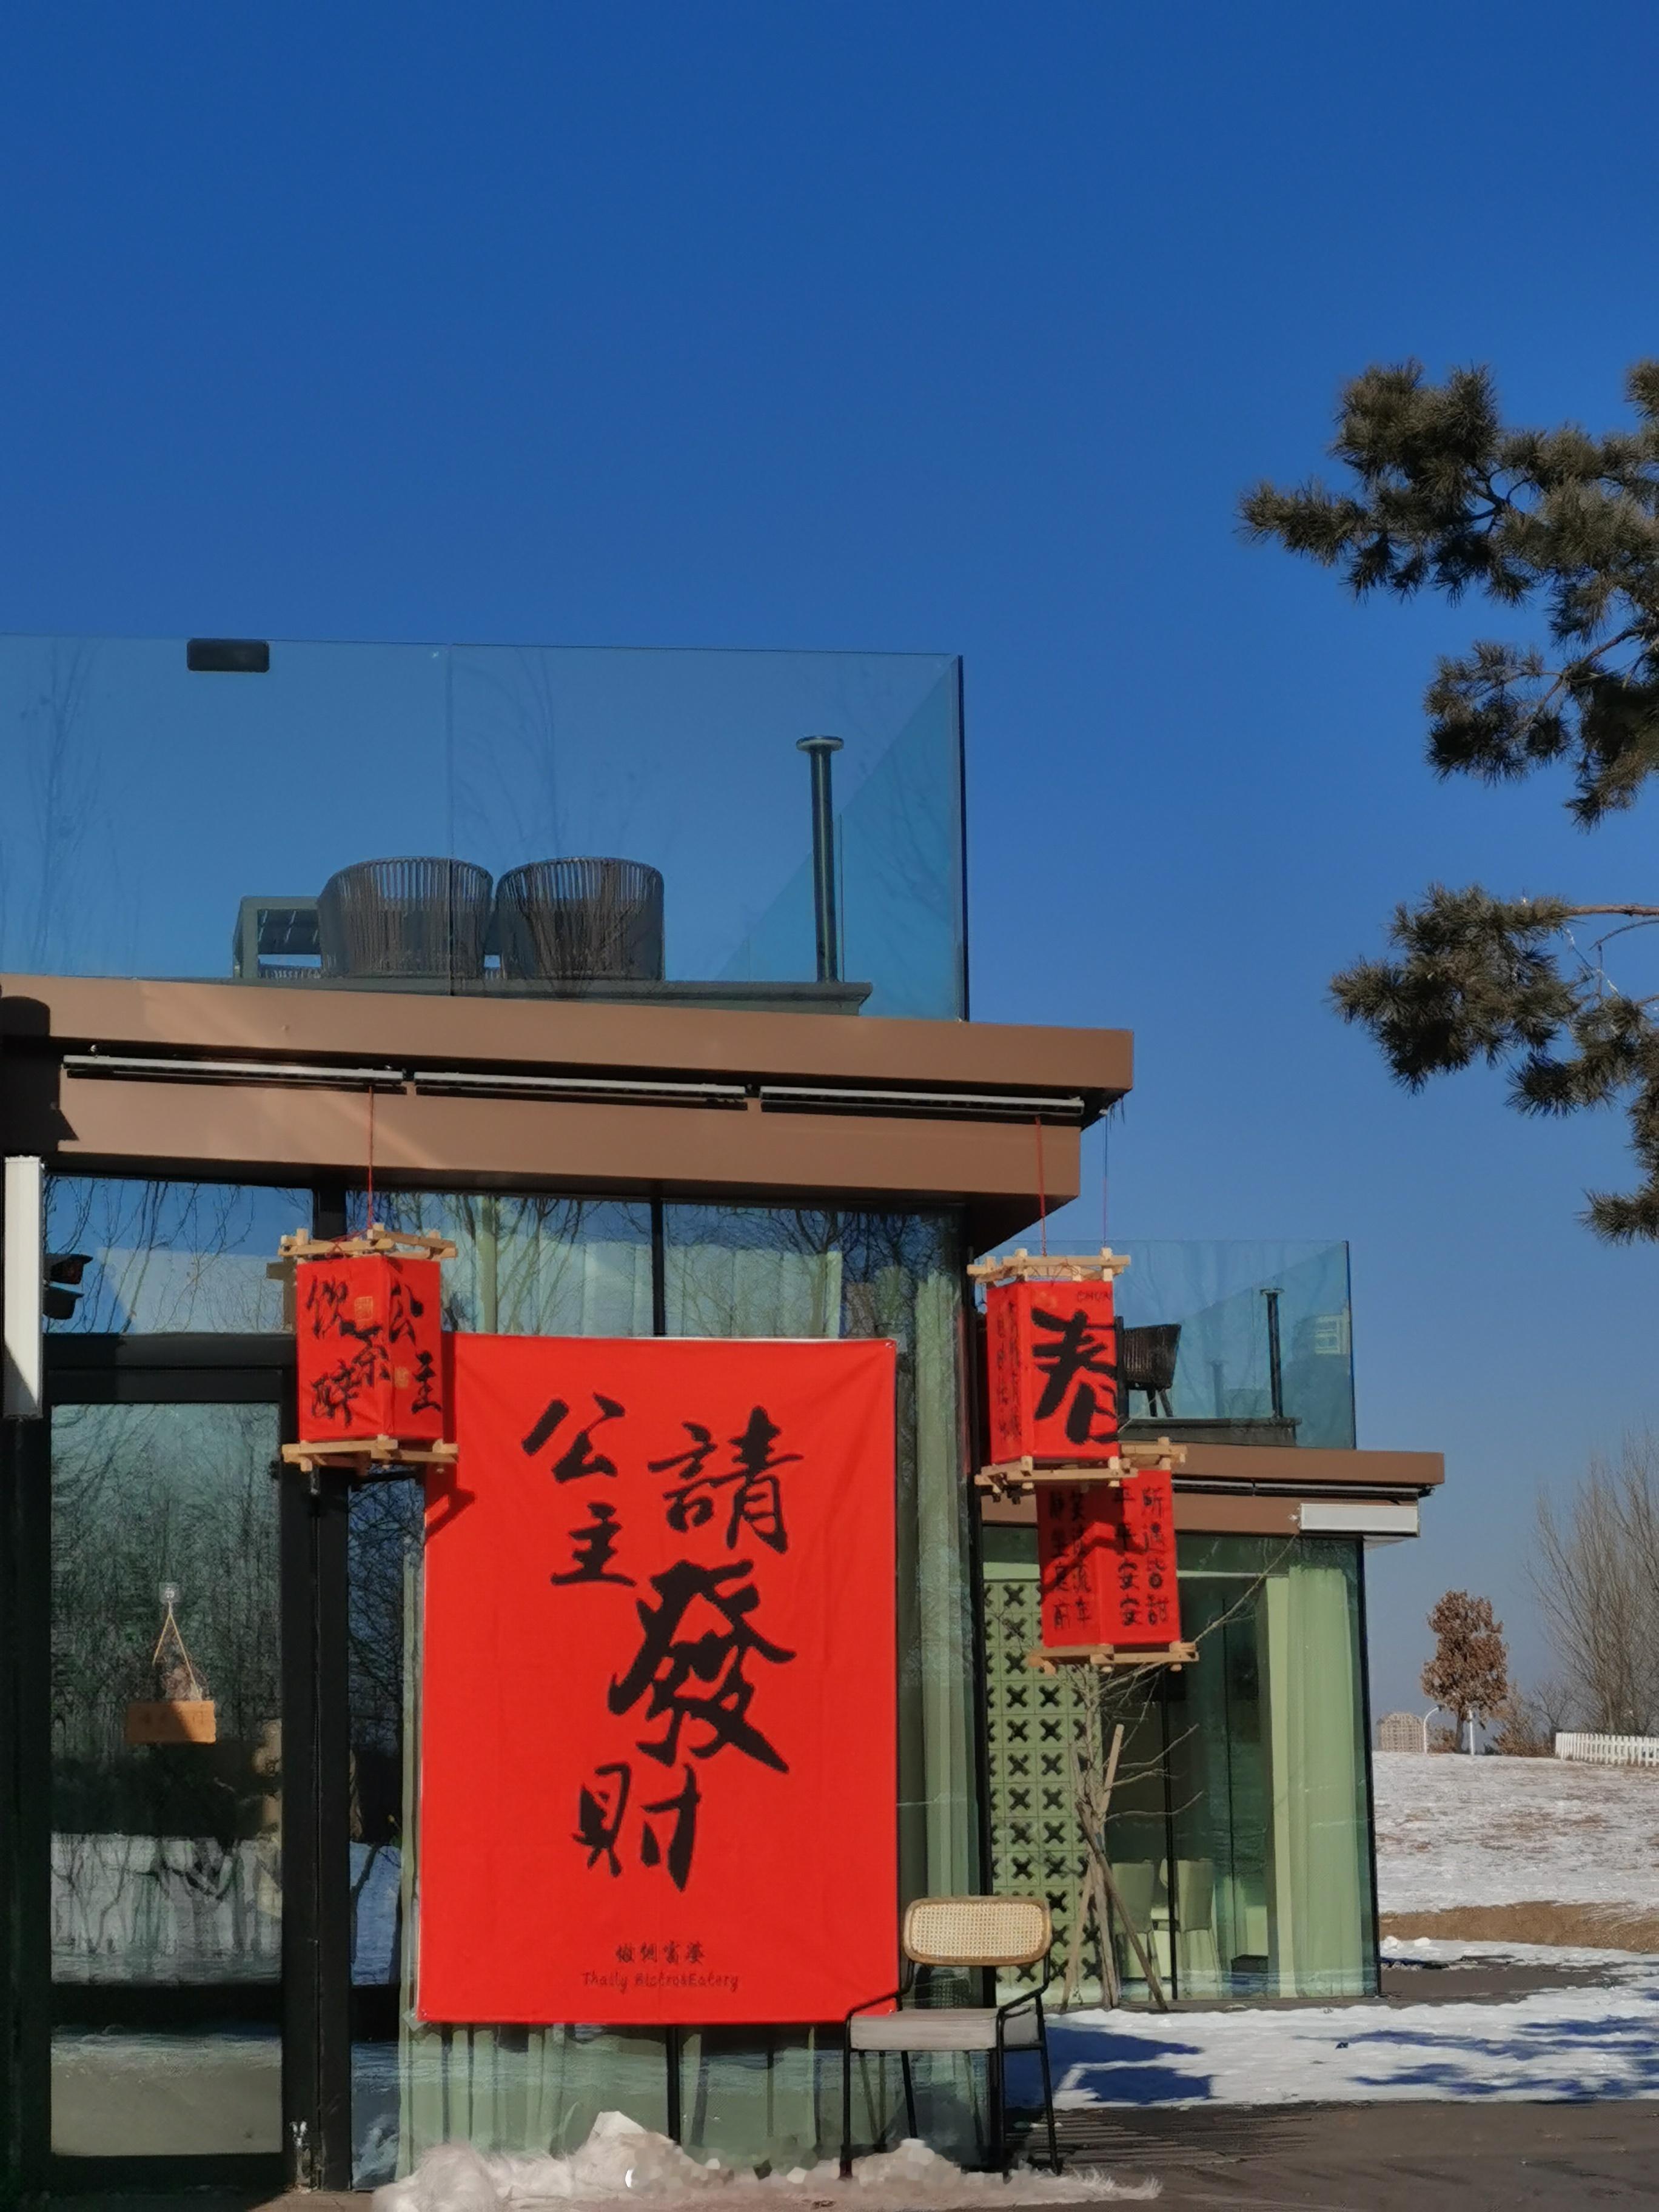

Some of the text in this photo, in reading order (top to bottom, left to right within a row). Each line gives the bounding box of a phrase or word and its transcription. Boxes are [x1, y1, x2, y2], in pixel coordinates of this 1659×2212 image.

[388, 1278, 443, 1415] 公主
[1031, 1307, 1119, 1446] 春
[521, 1392, 637, 1587] 公主
